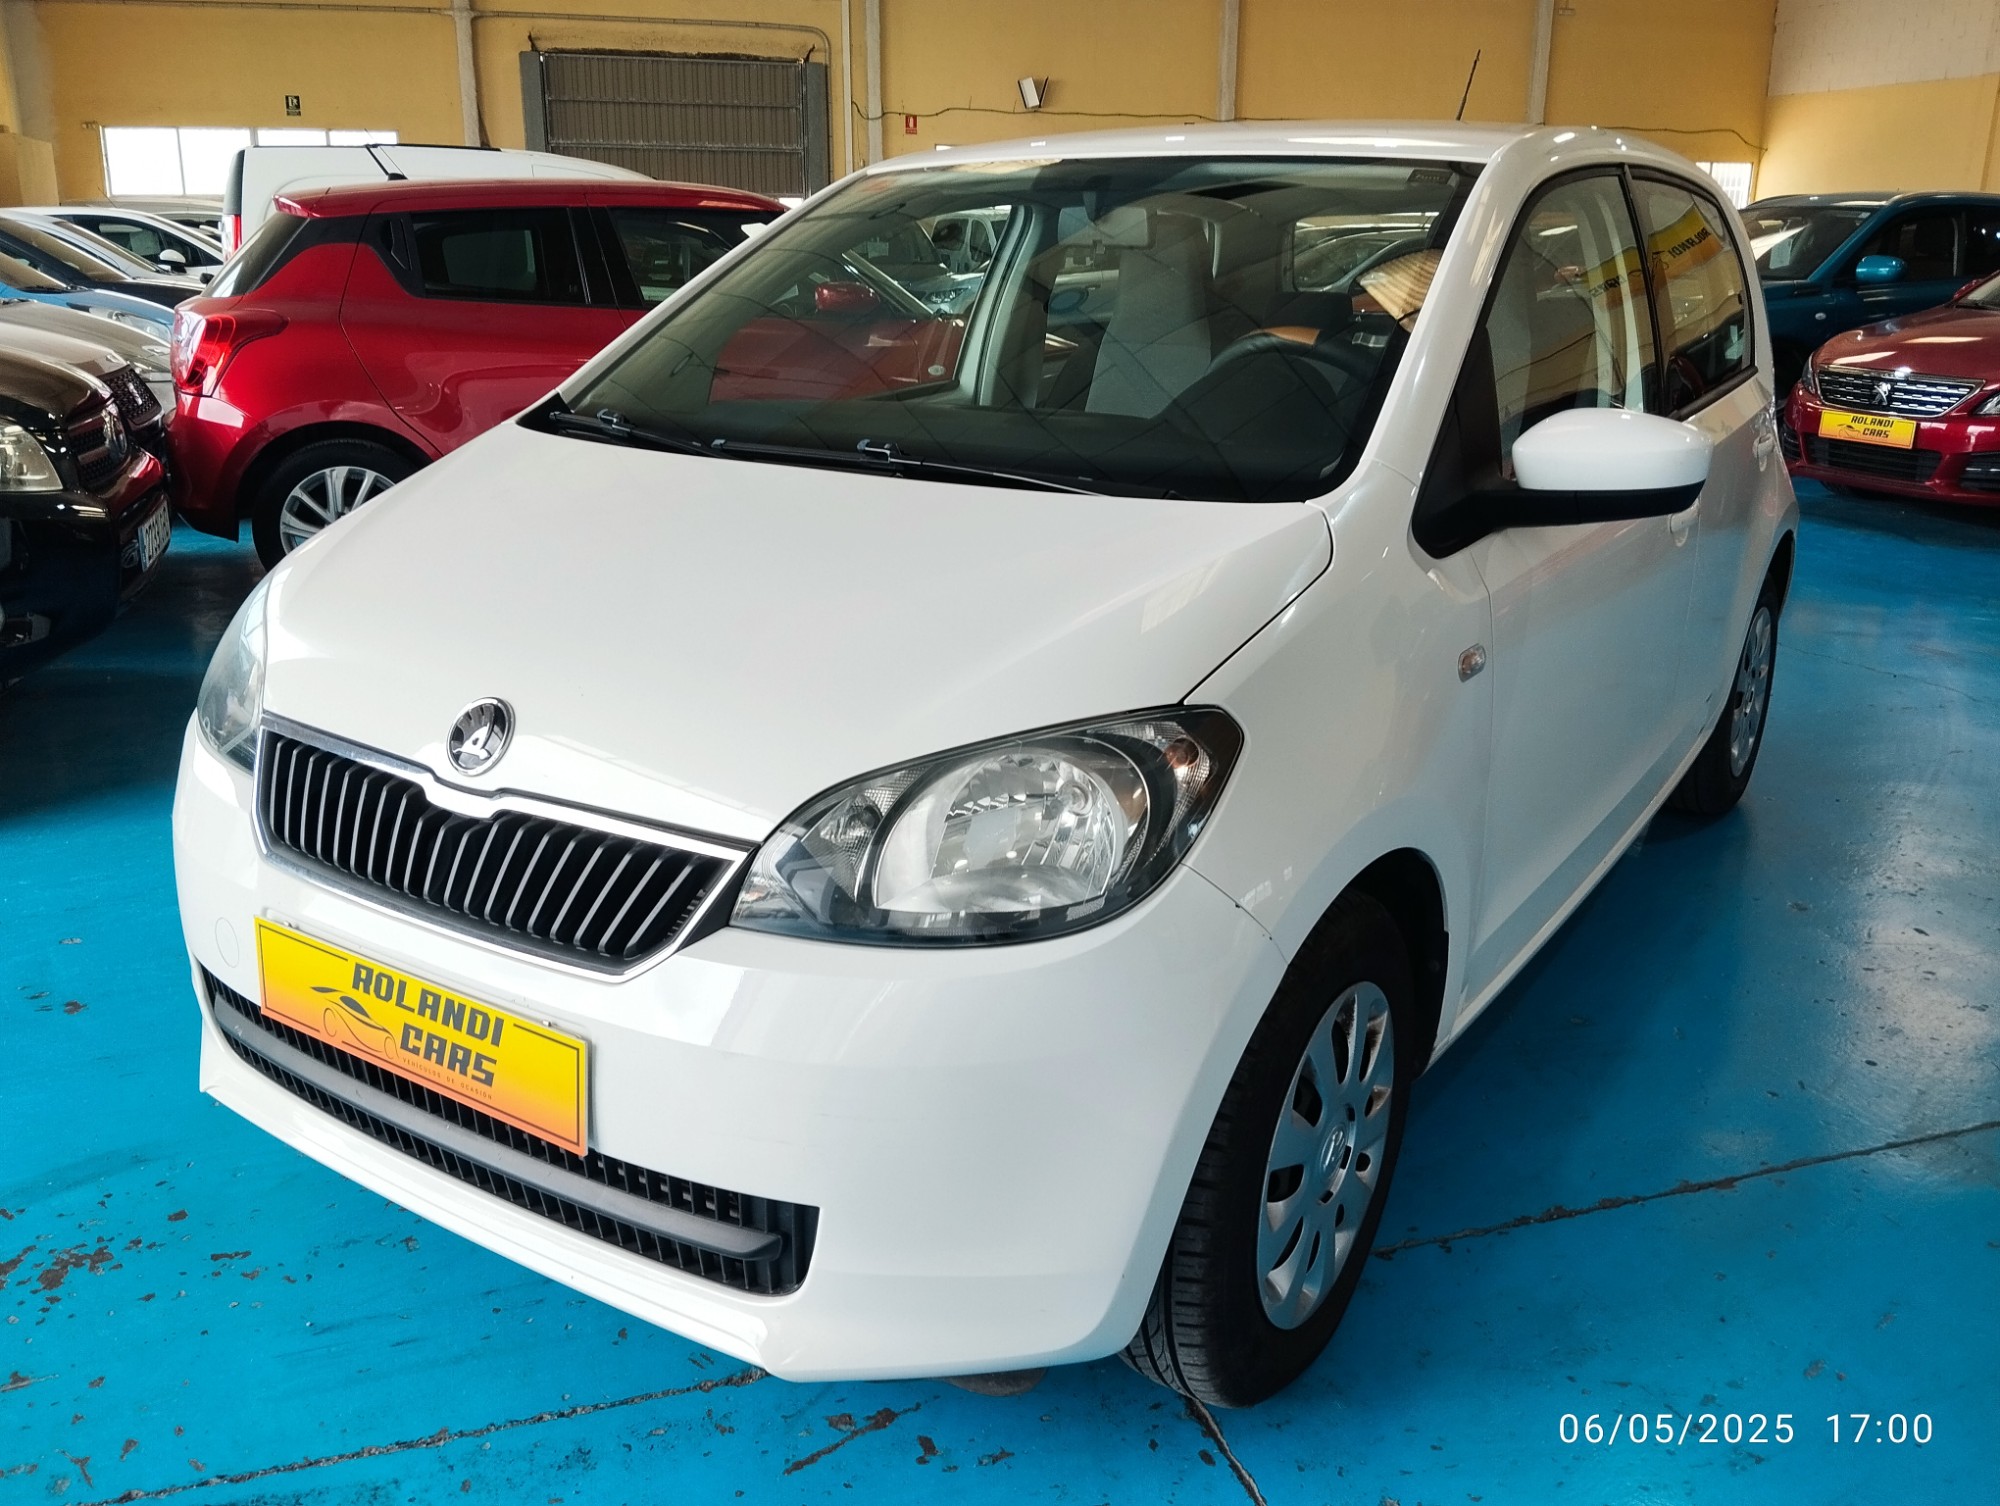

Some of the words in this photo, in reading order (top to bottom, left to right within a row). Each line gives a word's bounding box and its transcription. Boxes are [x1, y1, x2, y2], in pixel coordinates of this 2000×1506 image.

[1851, 415, 1894, 428] ROLANDI
[1862, 427, 1890, 438] CARS
[352, 962, 504, 1048] ROLANDI
[400, 1022, 497, 1088] CARS
